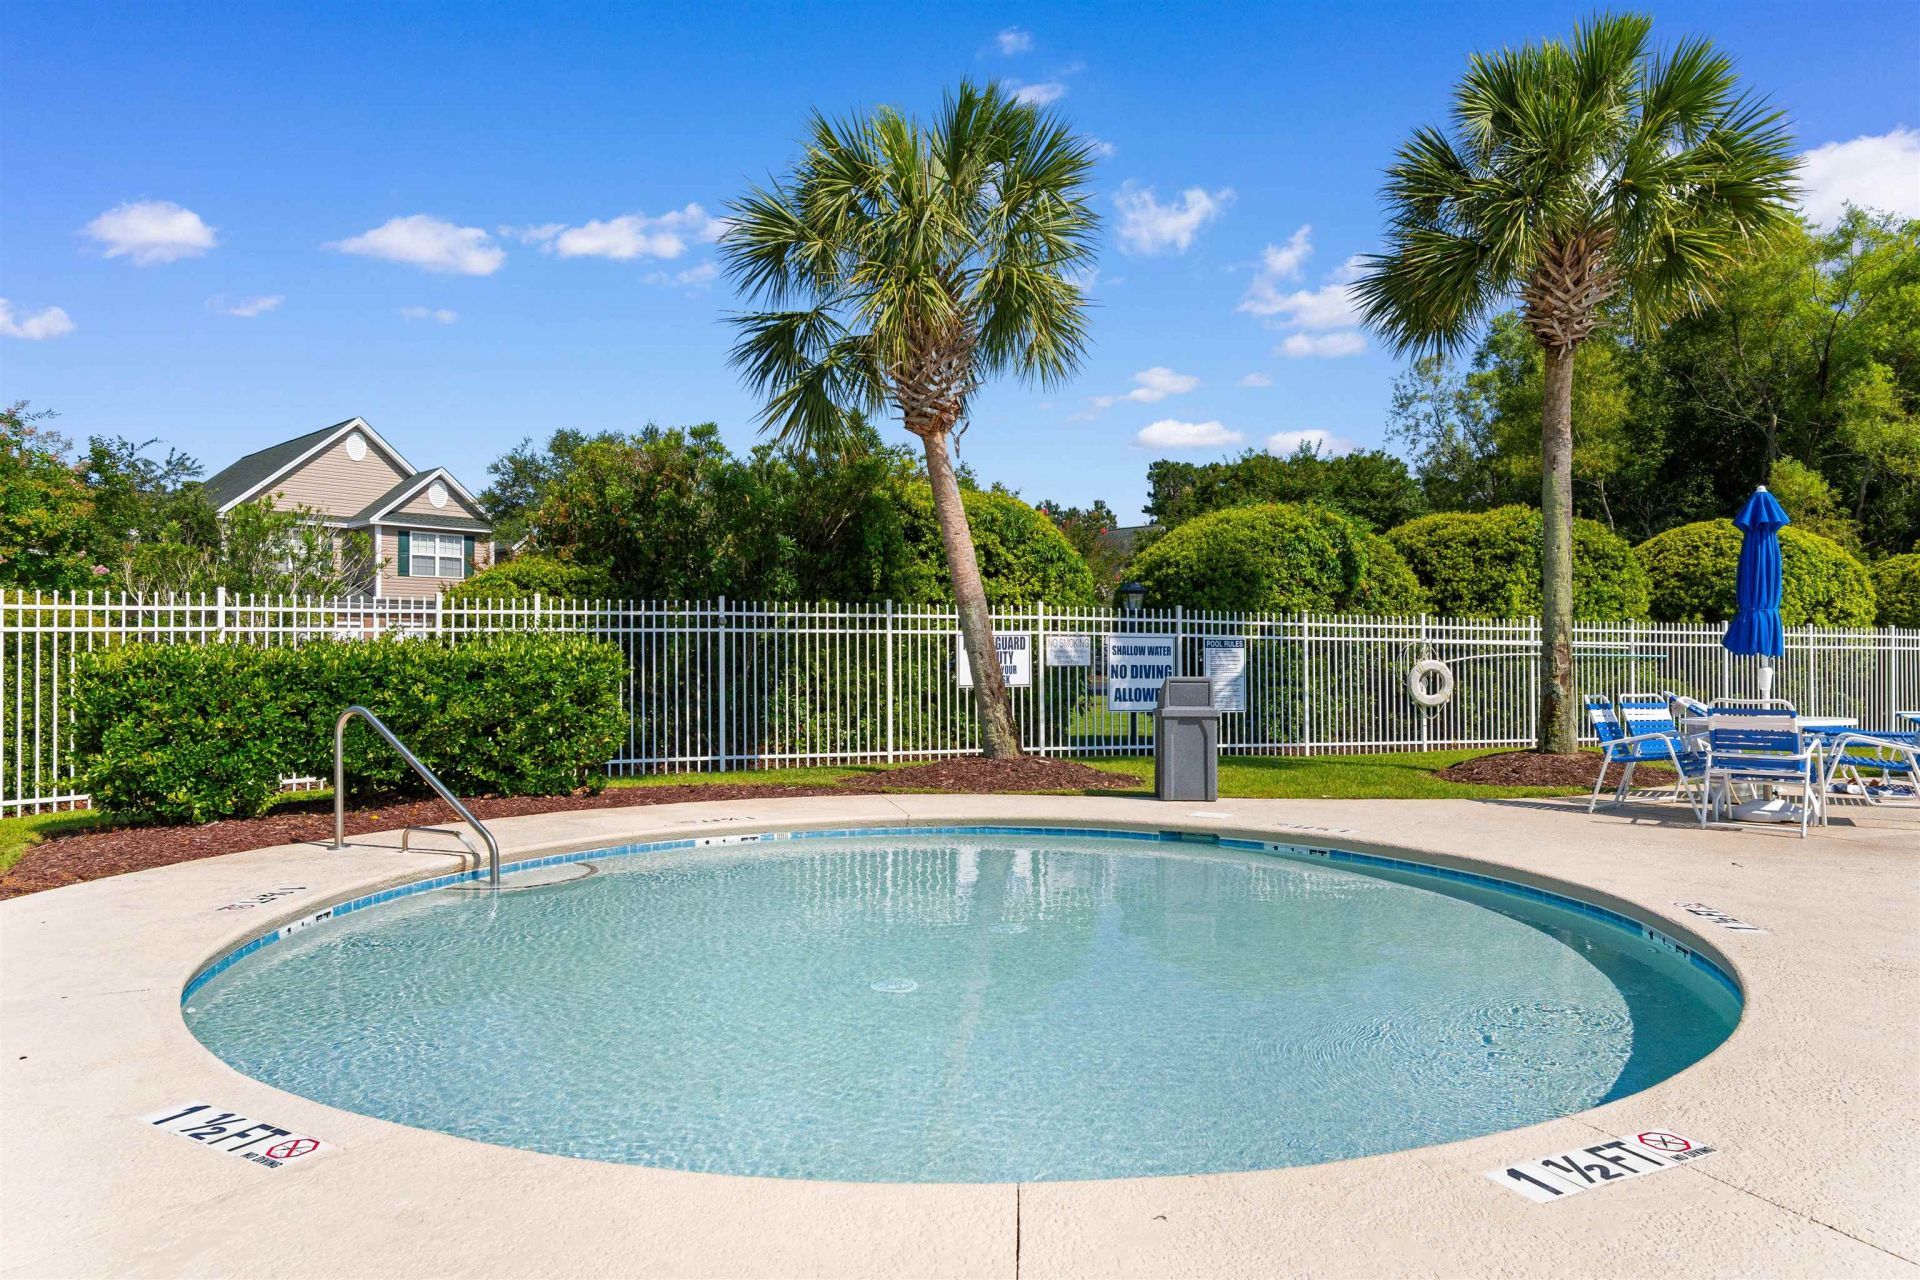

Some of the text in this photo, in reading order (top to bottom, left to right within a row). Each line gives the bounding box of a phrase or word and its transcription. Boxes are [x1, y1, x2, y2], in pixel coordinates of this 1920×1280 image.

[995, 636, 1026, 650] GUARD
[1048, 638, 1090, 648] NO SMOKING
[1206, 640, 1244, 648] POOL RULES
[1112, 645, 1172, 656] SHALLOW WATER
[997, 651, 1014, 664] UTY
[1110, 664, 1173, 679] NO DIVING
[152, 1105, 212, 1126] 1
[206, 1123, 293, 1152] FT
[240, 1152, 259, 1160] NO
[1506, 1168, 1564, 1196] 1
[1582, 1140, 1666, 1174] FT
